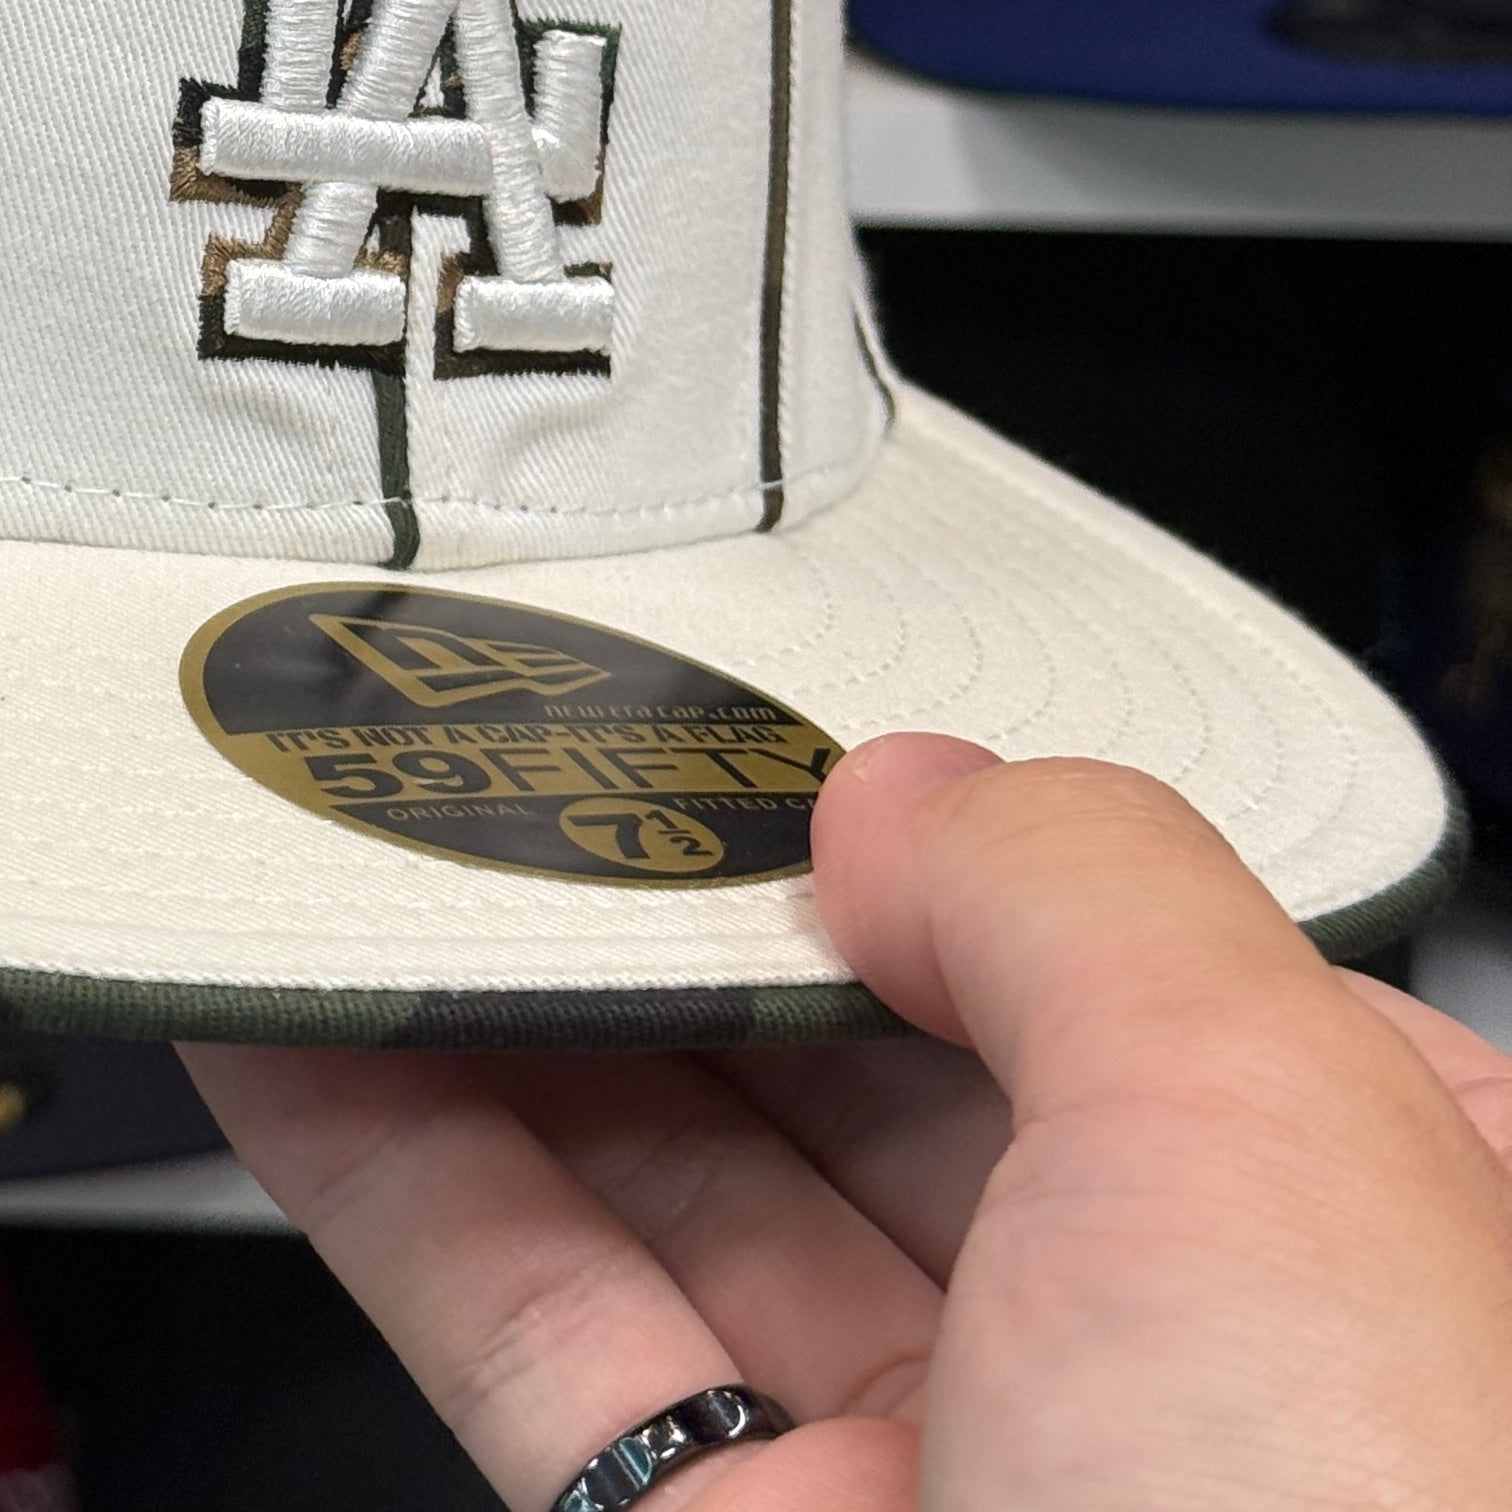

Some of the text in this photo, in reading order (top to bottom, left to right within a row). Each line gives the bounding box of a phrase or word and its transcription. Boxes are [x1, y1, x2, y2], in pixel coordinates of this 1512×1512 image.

[264, 729, 352, 753] IT'S
[351, 725, 434, 748] NOT
[441, 725, 472, 745] A
[651, 724, 685, 744] A
[682, 724, 788, 744] FLAG
[303, 748, 831, 799] 59FIFTY
[385, 803, 533, 822] ORIGINAL
[672, 796, 778, 811] FITTED
